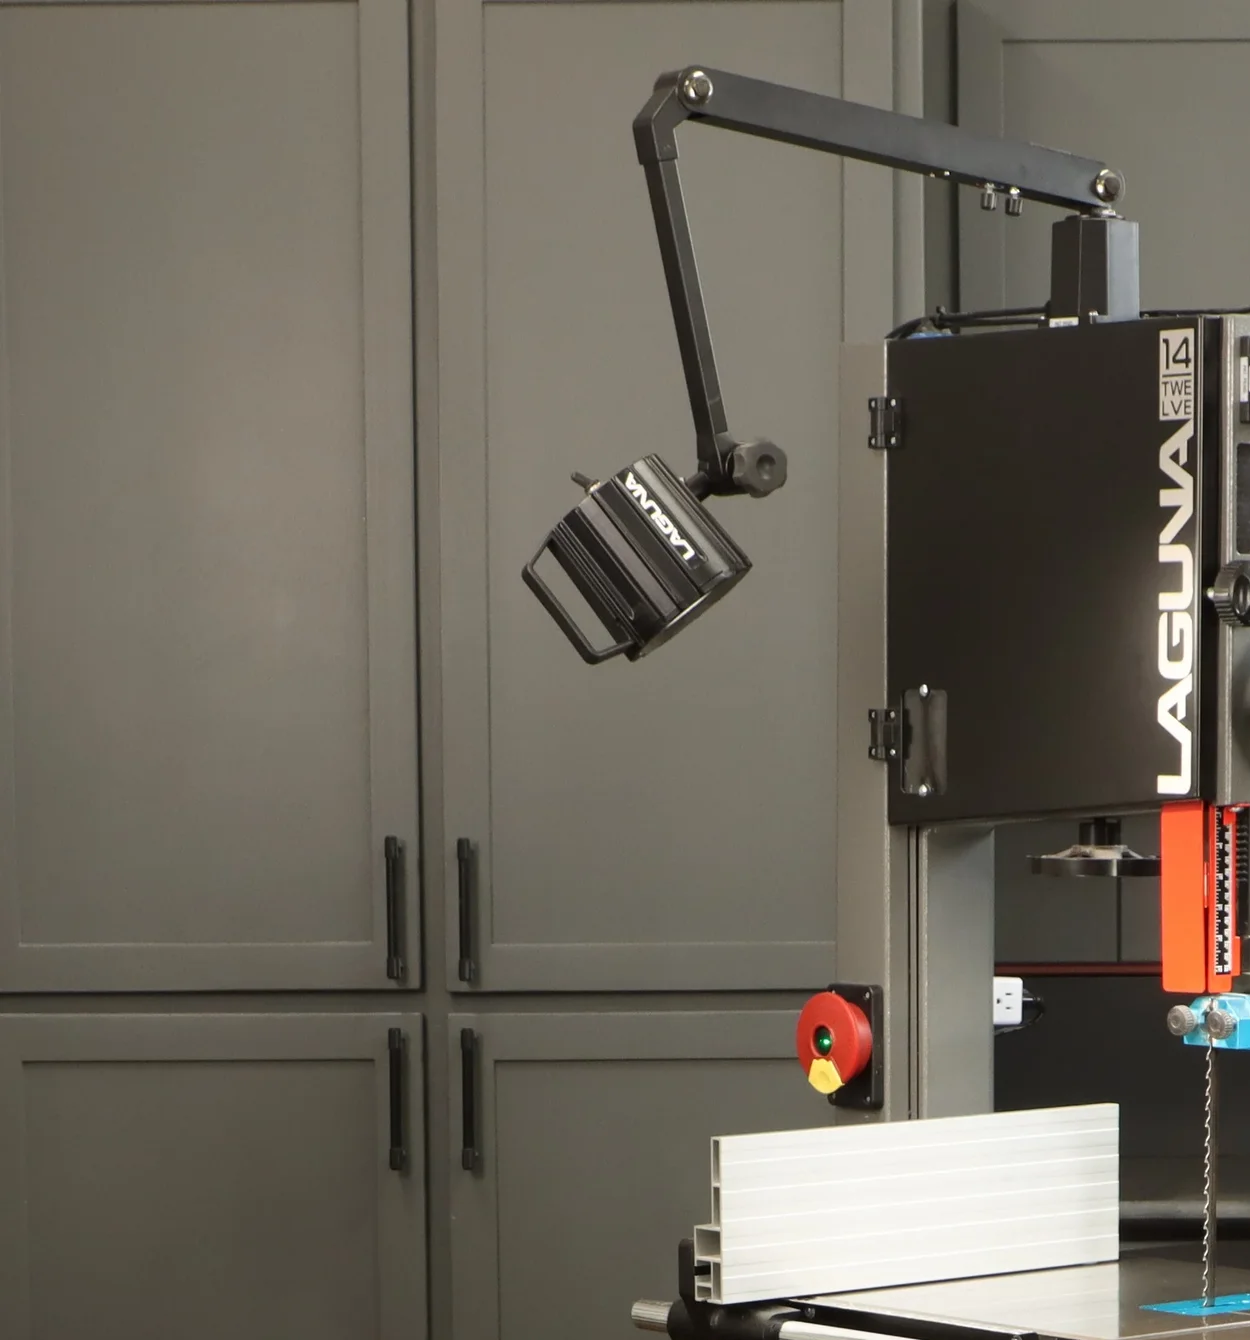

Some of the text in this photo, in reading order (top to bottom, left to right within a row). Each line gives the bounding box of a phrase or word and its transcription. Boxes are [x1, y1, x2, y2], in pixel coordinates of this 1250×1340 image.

[1162, 336, 1192, 370] 14
[1161, 380, 1192, 397] TWE
[1162, 400, 1192, 416] LVE
[625, 471, 695, 560] LAGUNA
[1157, 419, 1194, 795] LAGUNA
